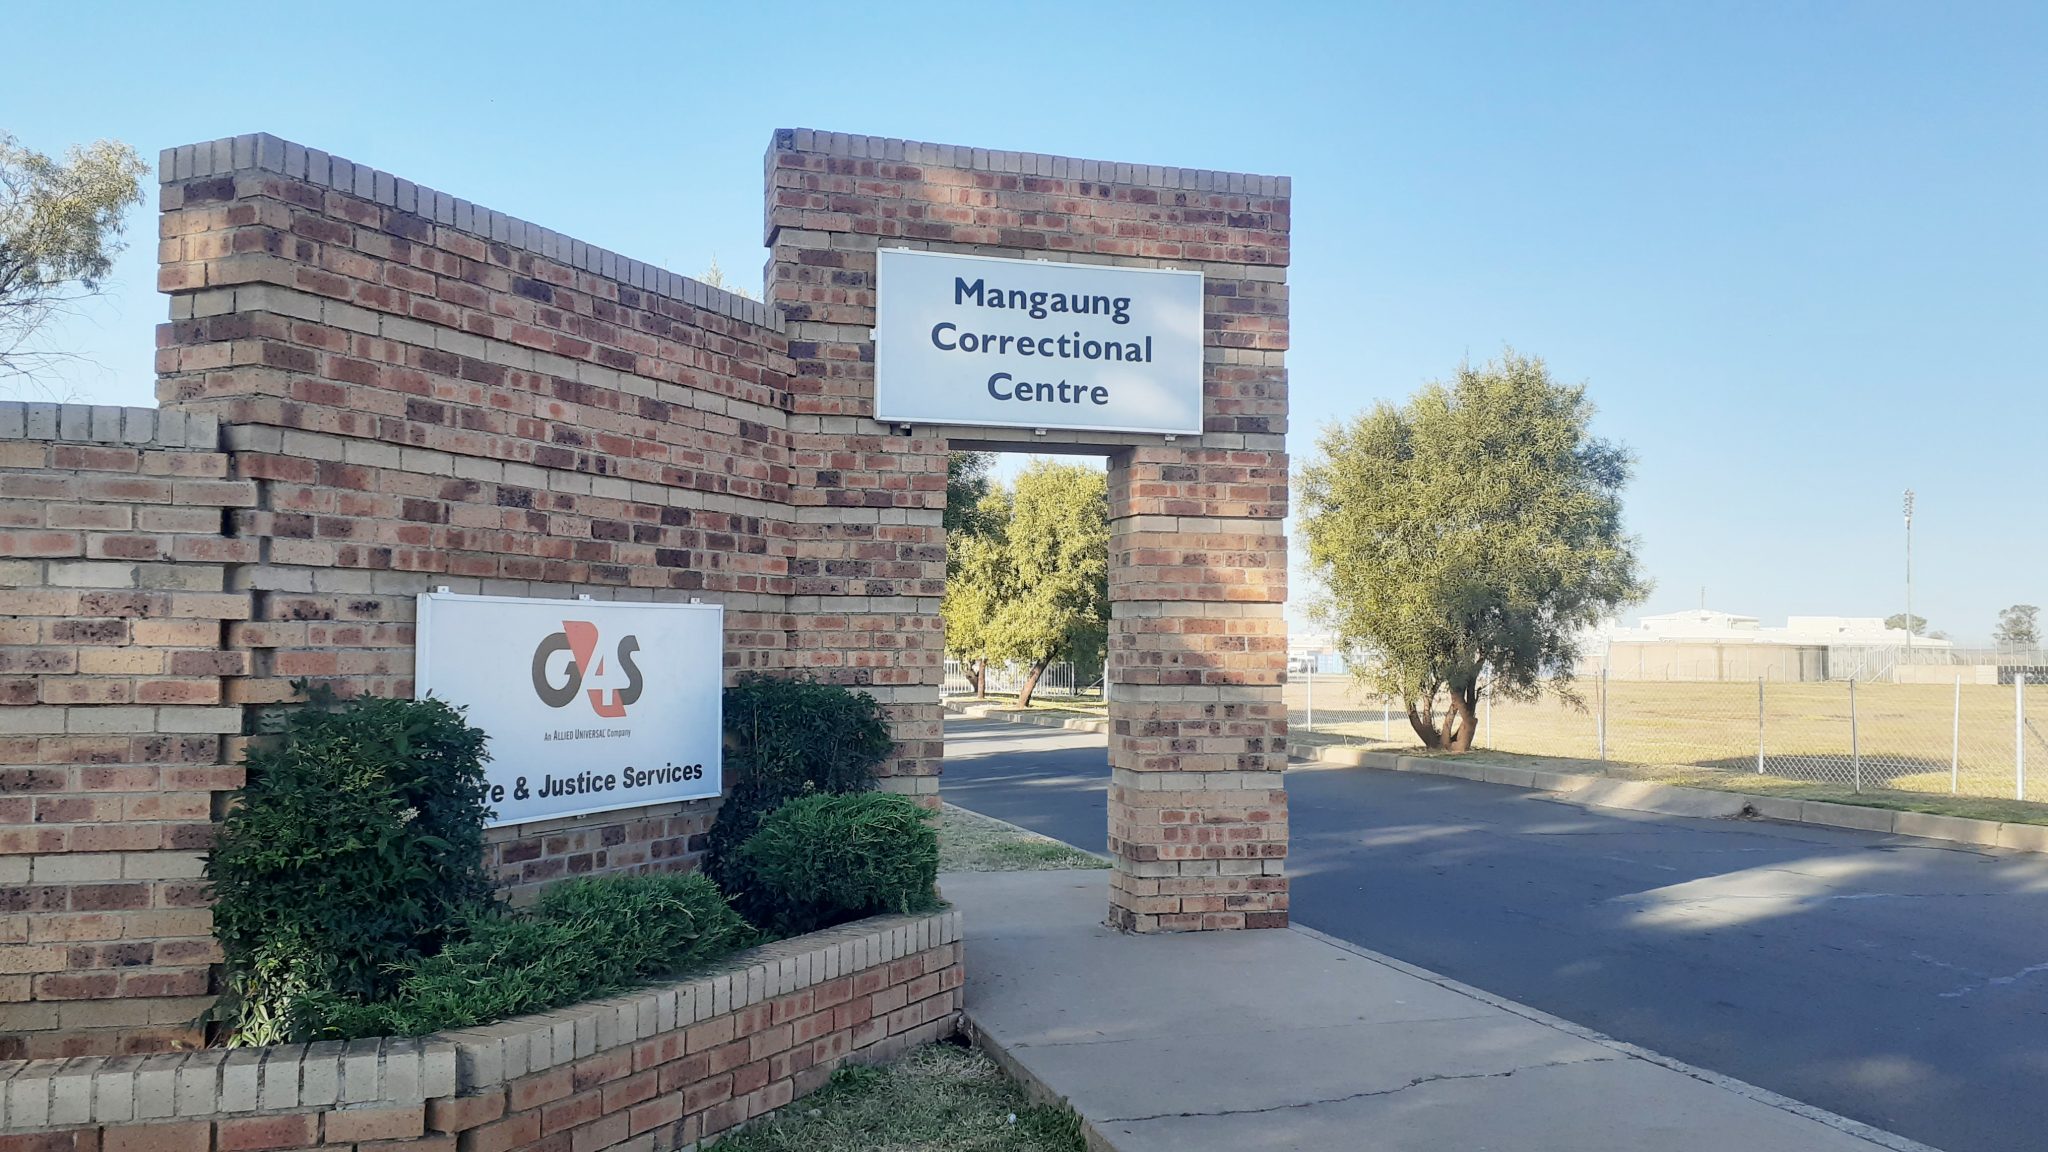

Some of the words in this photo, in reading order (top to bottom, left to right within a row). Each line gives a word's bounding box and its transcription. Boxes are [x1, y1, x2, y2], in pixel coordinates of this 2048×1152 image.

[955, 277, 1131, 324] Mangaung
[931, 322, 1152, 363] Correctional
[988, 372, 1109, 405] Centre
[532, 620, 643, 718] G4S
[544, 732, 552, 741] An
[553, 730, 574, 741] ALLIED
[575, 728, 605, 740] UNIVERSAL
[607, 728, 632, 738] Company
[513, 776, 530, 801] &
[539, 771, 616, 798] Justice
[623, 762, 703, 786] Services
